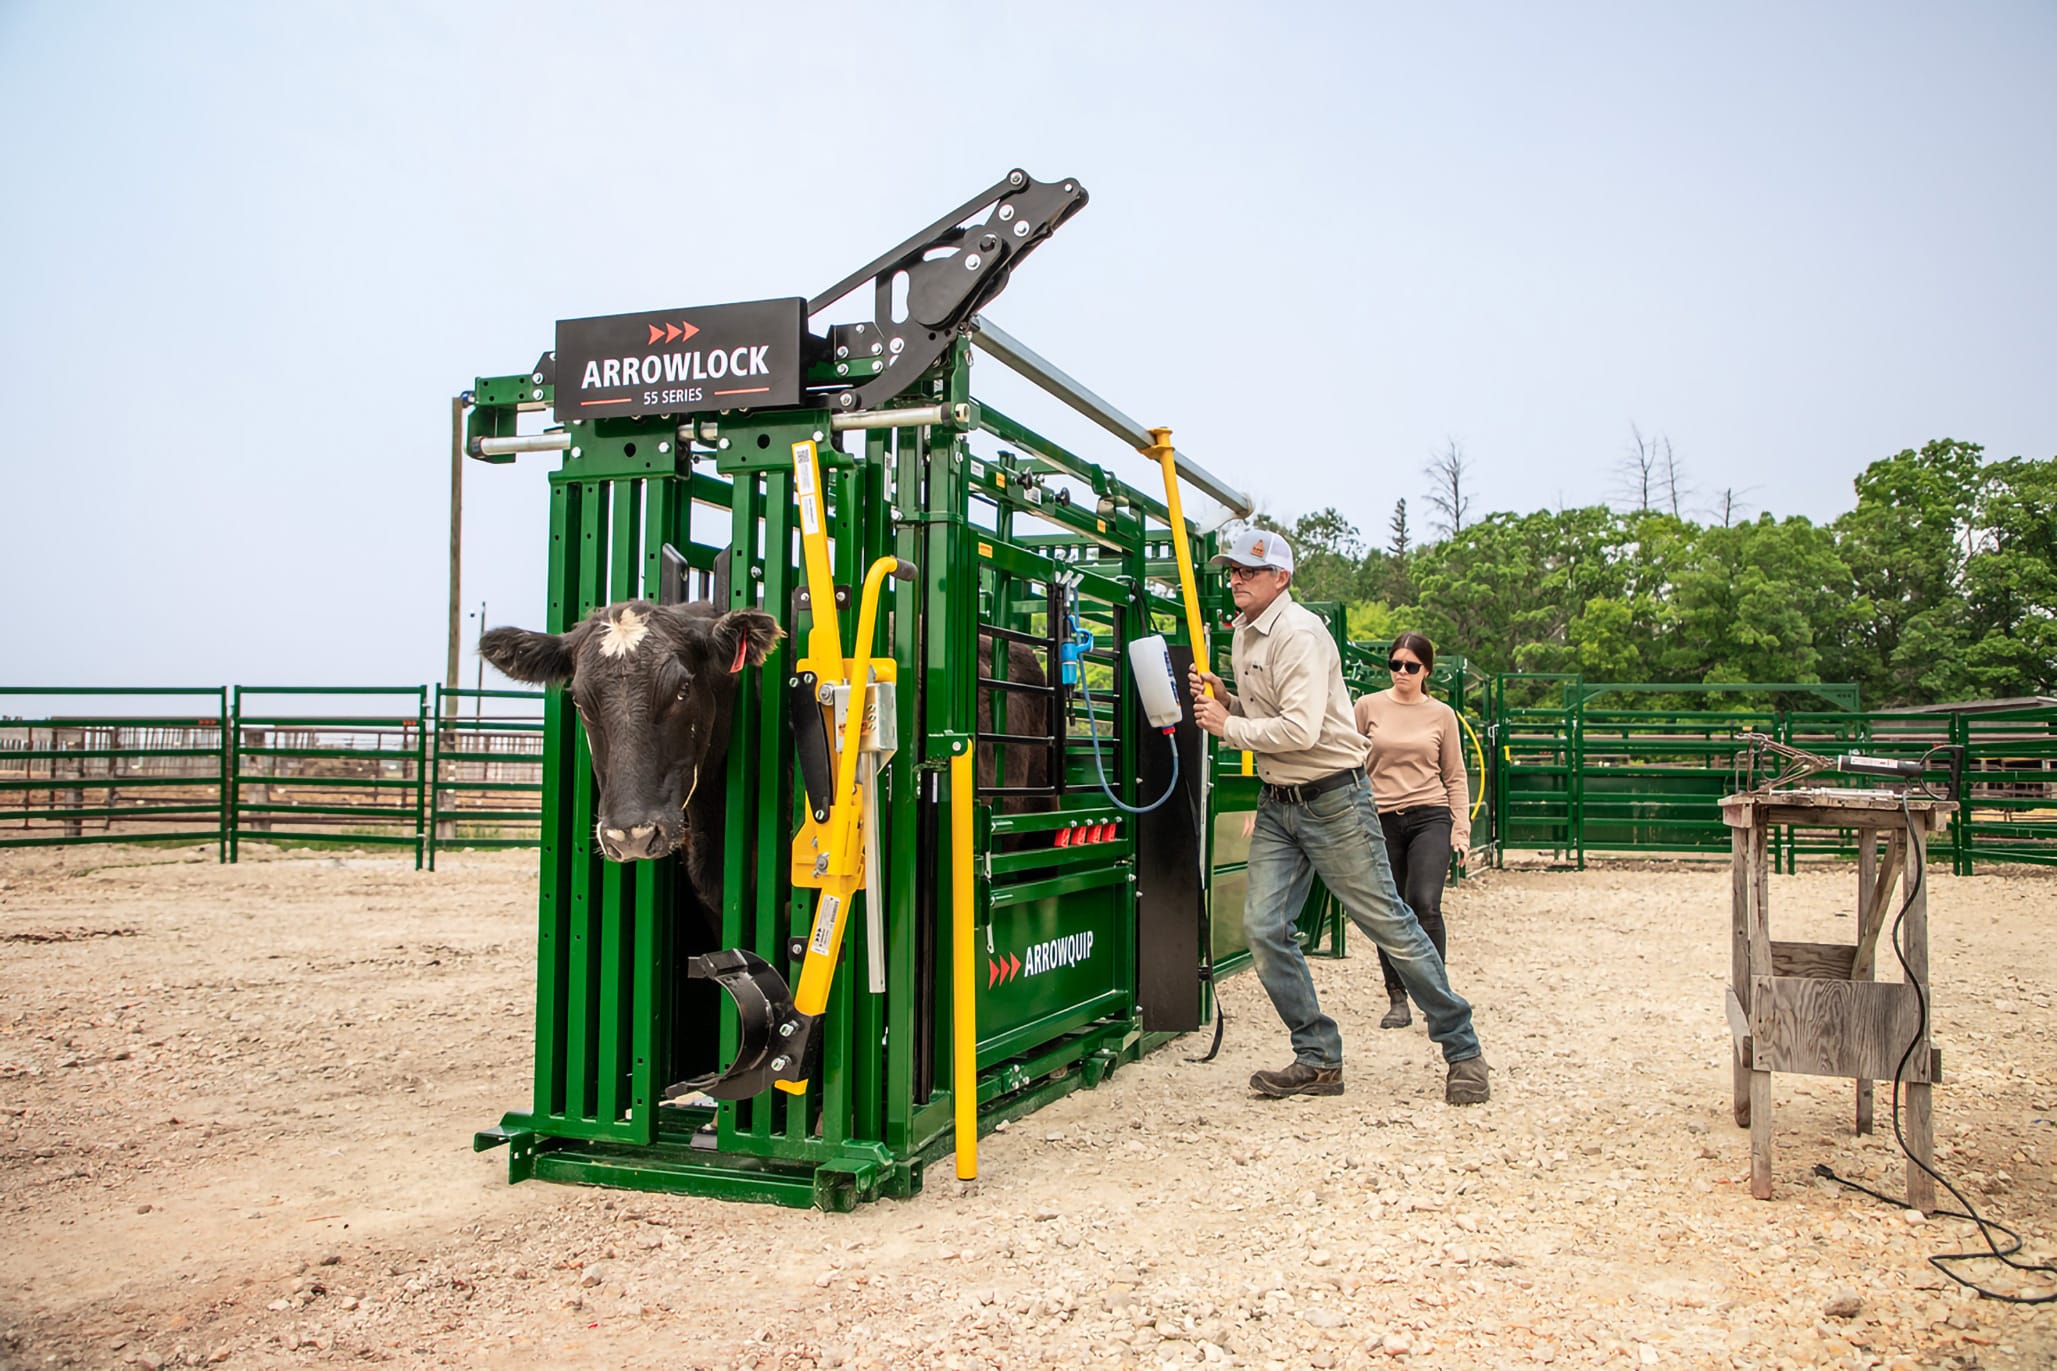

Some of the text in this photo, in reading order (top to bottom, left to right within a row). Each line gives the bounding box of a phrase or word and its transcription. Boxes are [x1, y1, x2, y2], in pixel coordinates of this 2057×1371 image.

[581, 345, 770, 389] ARROWLOCK
[643, 387, 703, 405] 55 SERIES
[1024, 930, 1094, 978] ARROWQUIP
